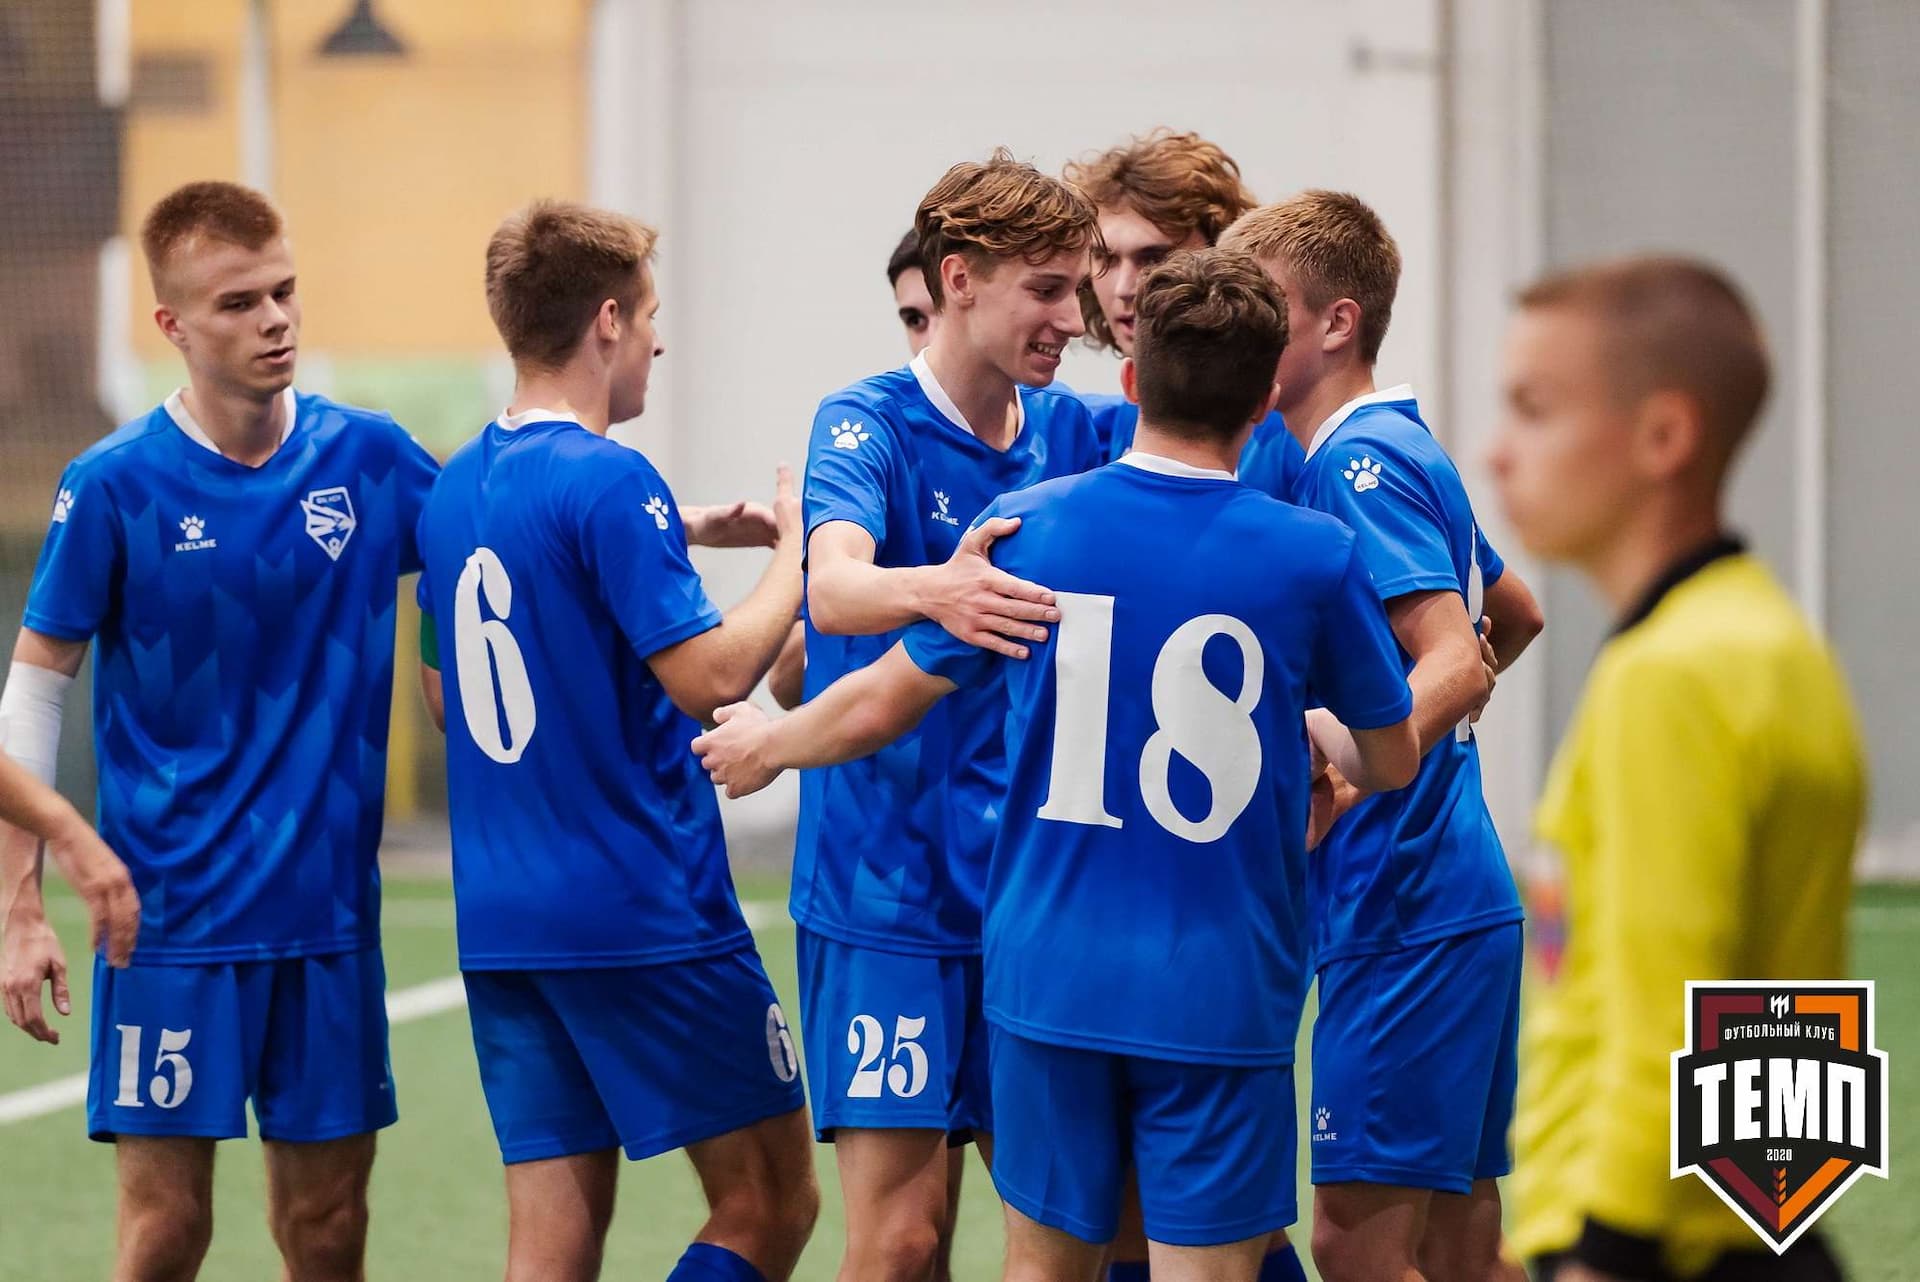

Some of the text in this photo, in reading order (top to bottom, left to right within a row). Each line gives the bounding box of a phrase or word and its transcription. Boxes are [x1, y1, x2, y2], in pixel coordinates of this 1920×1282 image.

[175, 539, 217, 552] KELME
[454, 547, 537, 764] 6
[1037, 591, 1264, 843] 18
[113, 1024, 193, 1109] 15
[766, 1003, 797, 1082] 6
[847, 1015, 929, 1098] 25
